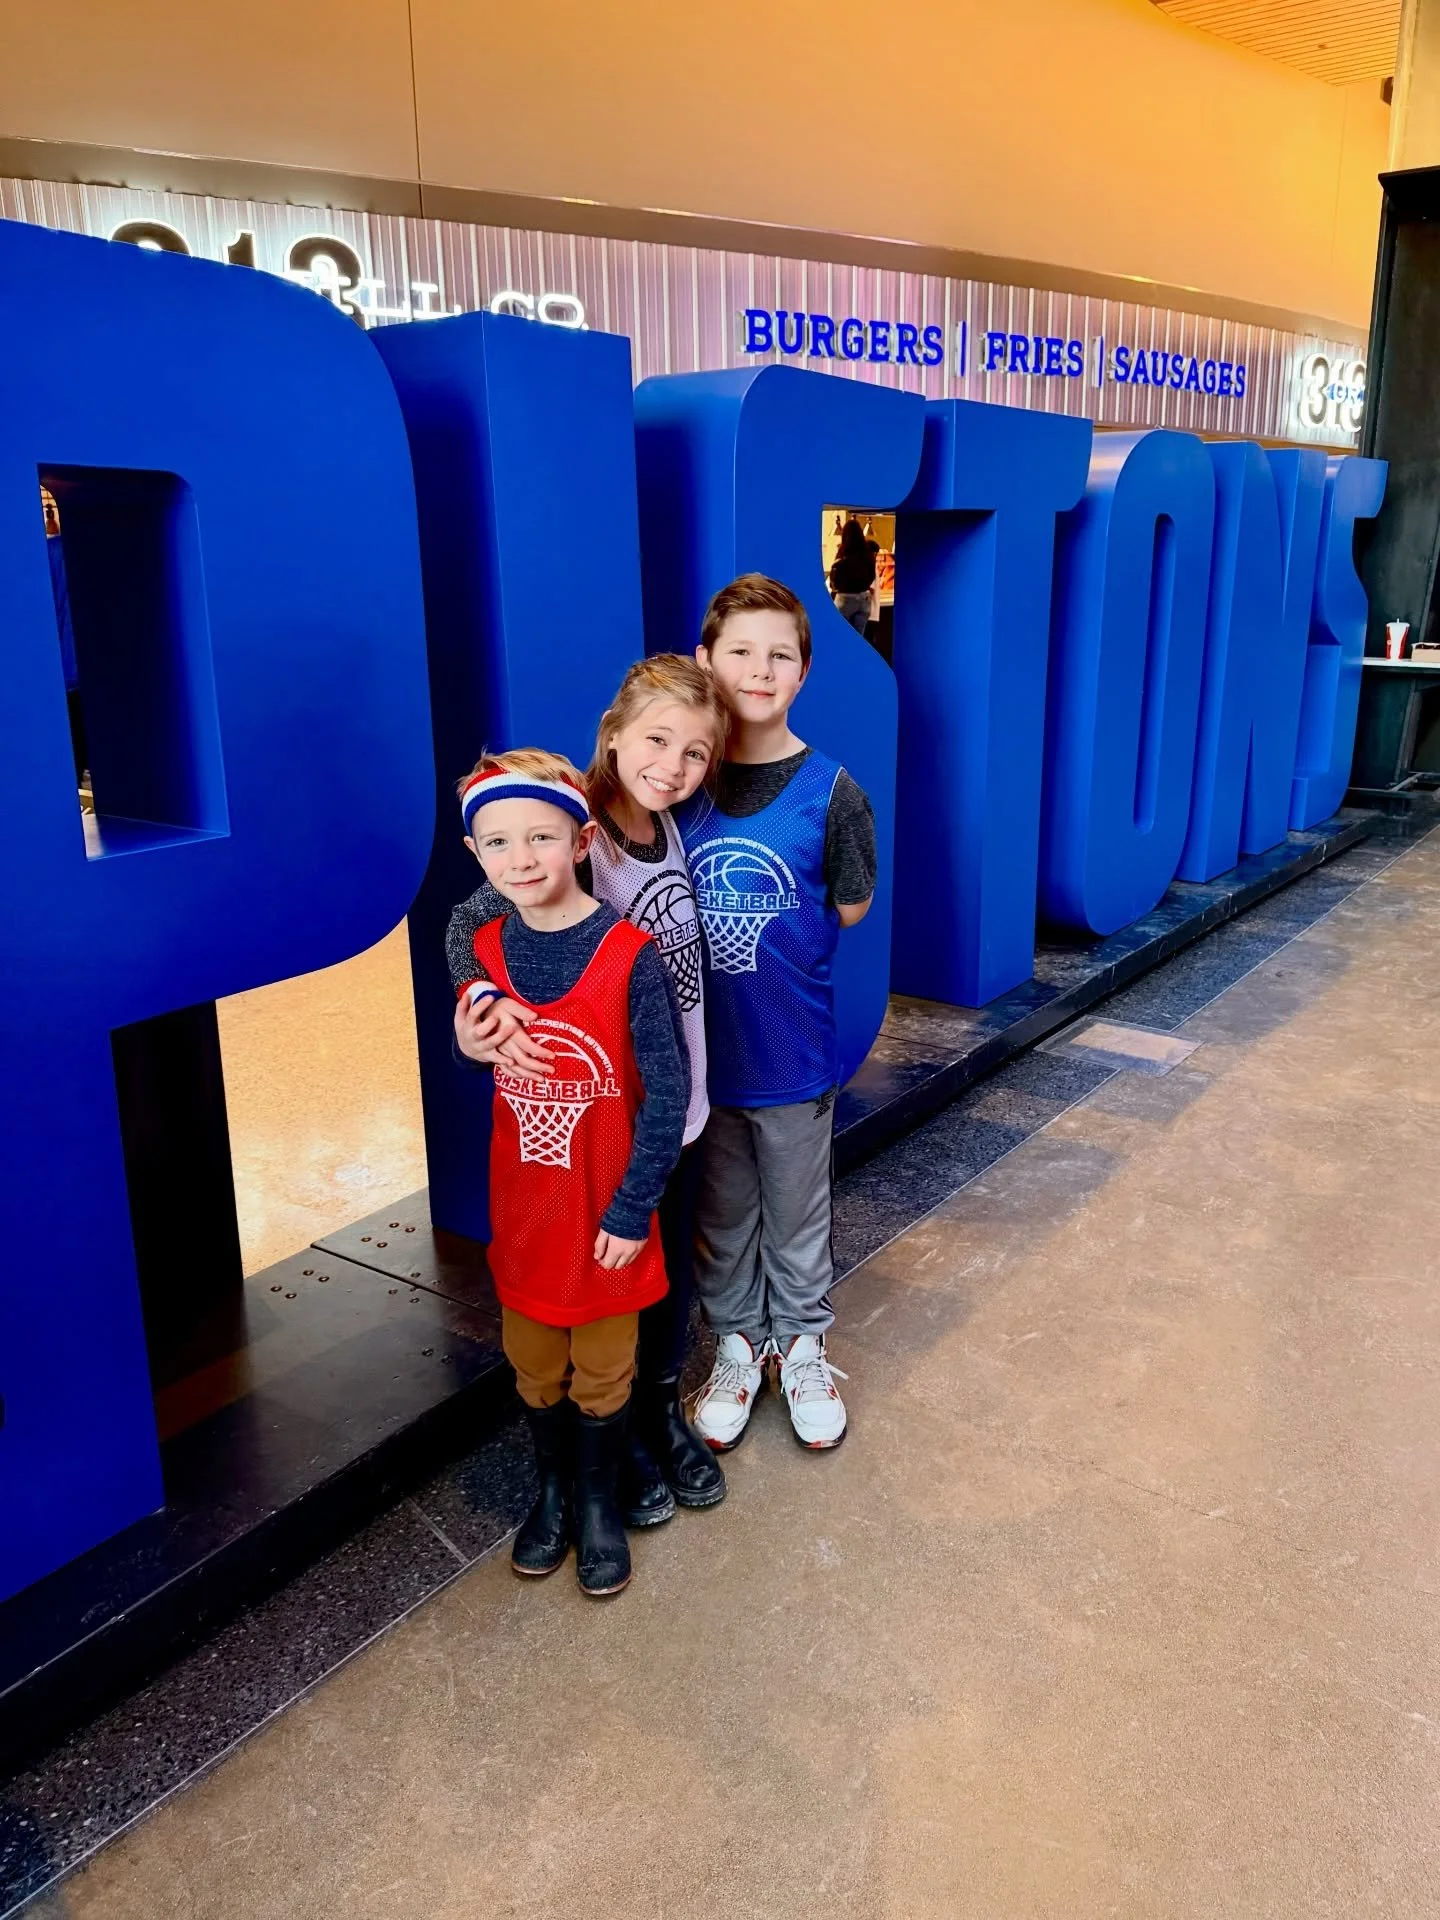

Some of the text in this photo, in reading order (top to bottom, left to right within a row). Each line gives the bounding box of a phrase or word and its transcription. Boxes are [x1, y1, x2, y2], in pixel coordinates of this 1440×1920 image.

[745, 309, 1246, 398] BURGERS FRIES SAUSAGES
[0, 222, 1388, 1602] PISTONS
[696, 888, 800, 910] SKETBALL
[494, 1064, 620, 1100] BASKETBALL
